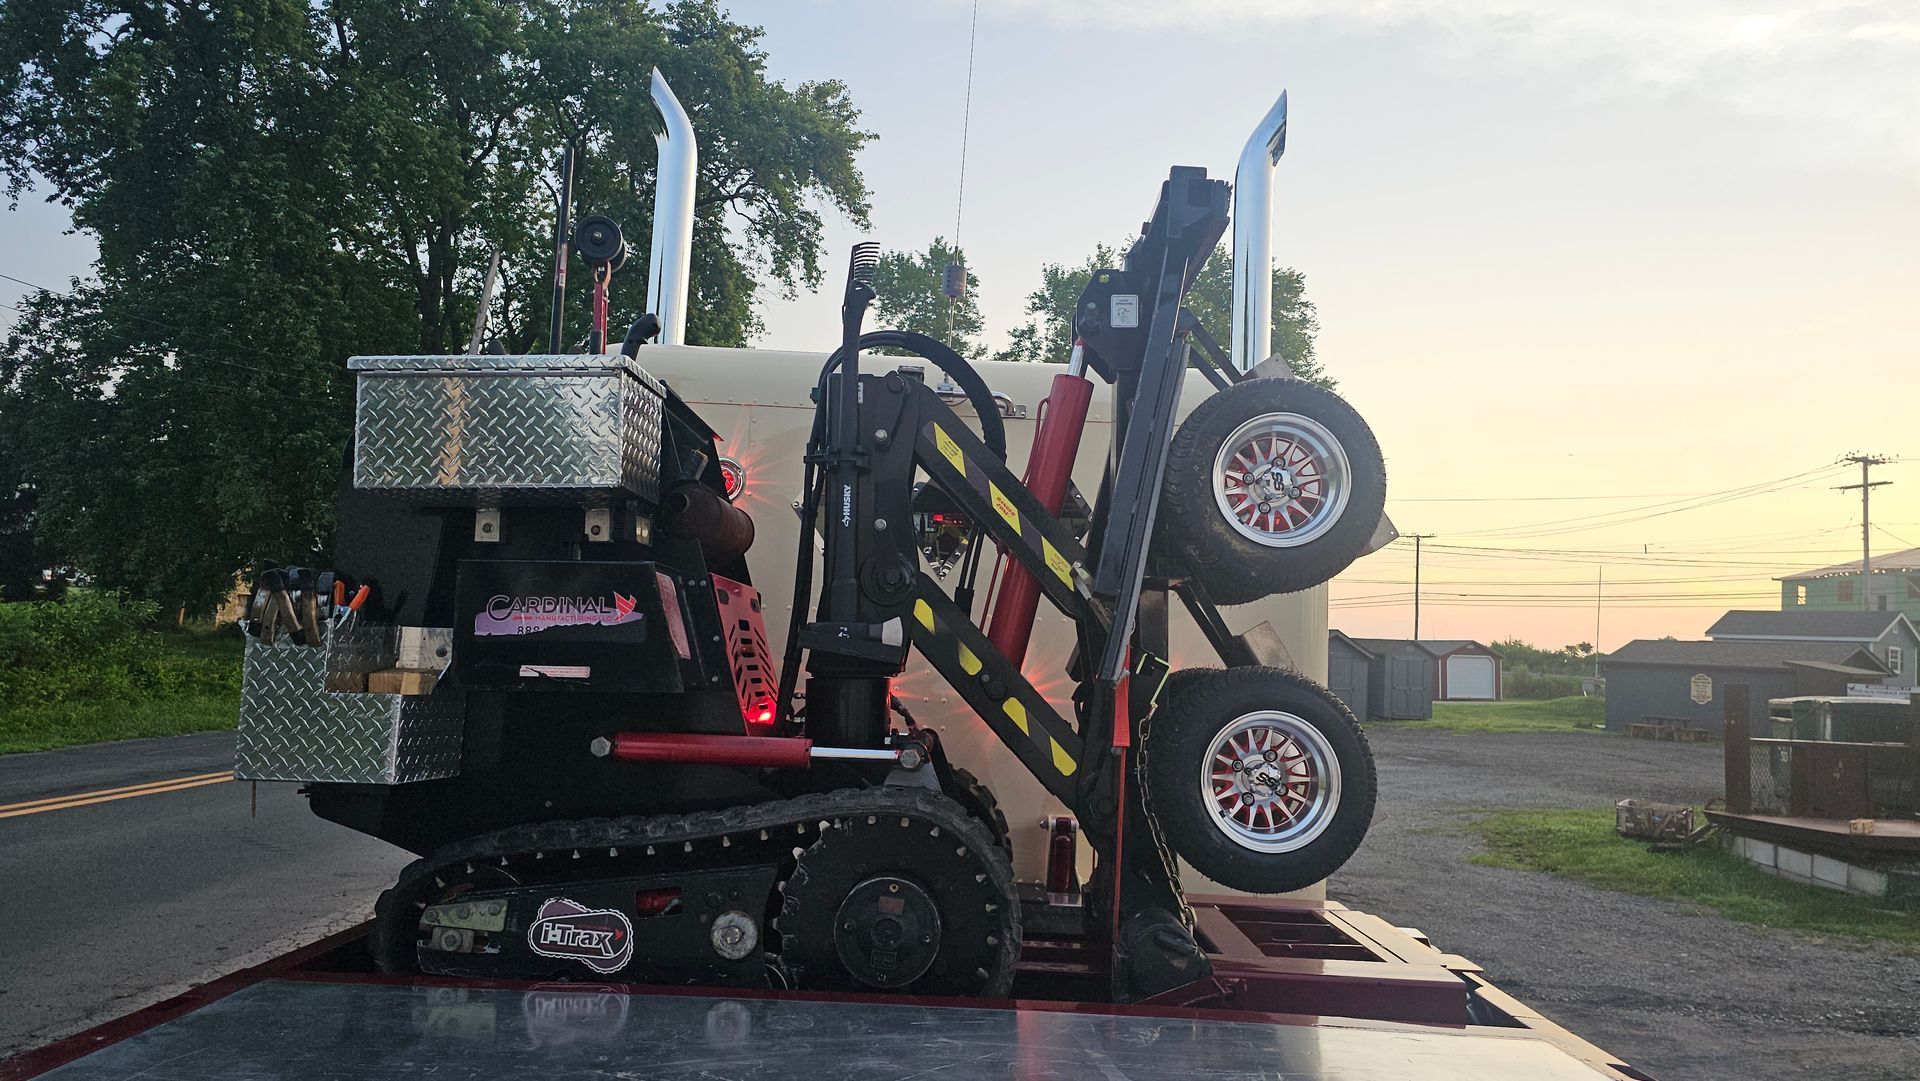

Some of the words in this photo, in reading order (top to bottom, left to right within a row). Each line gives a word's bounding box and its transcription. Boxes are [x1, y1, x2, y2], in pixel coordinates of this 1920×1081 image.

[843, 485, 851, 516] HUSKY
[486, 594, 612, 623] CARDINAL
[540, 922, 615, 956] i-Trax
